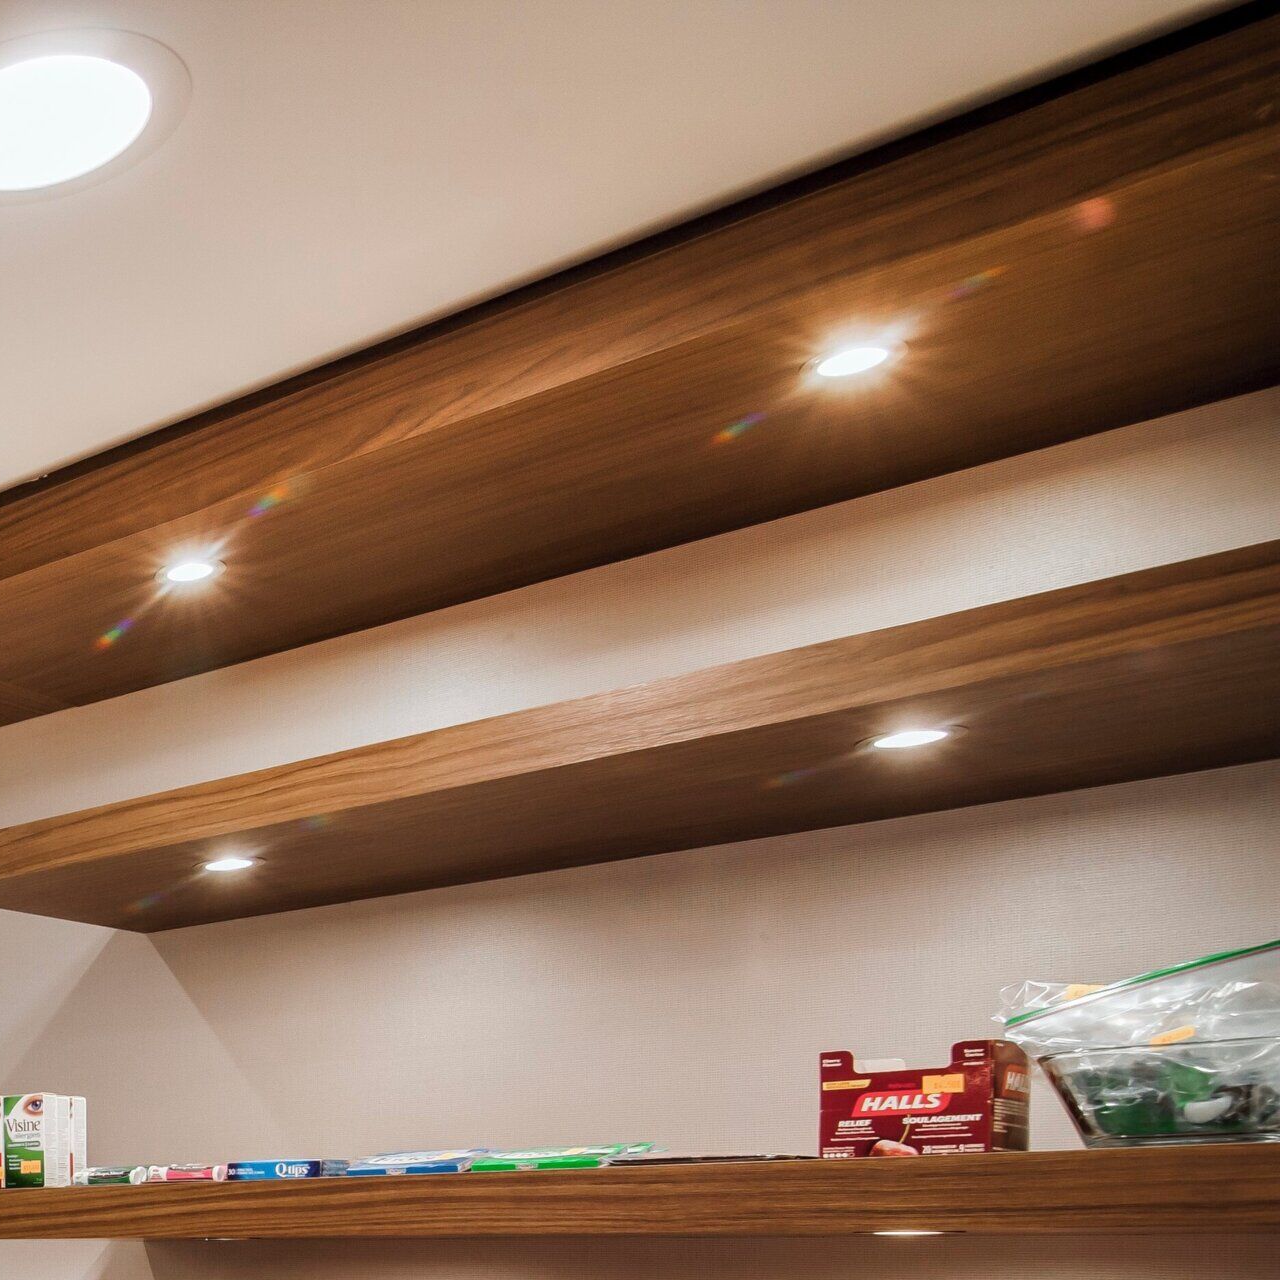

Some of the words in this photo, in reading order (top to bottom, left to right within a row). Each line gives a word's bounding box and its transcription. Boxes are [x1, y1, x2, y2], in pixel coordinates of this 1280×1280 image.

[860, 1093, 941, 1112] HALLS
[6, 1118, 41, 1133] Visine
[839, 1119, 873, 1128] RELIEF
[902, 1113, 984, 1125] SOULAGEMENT
